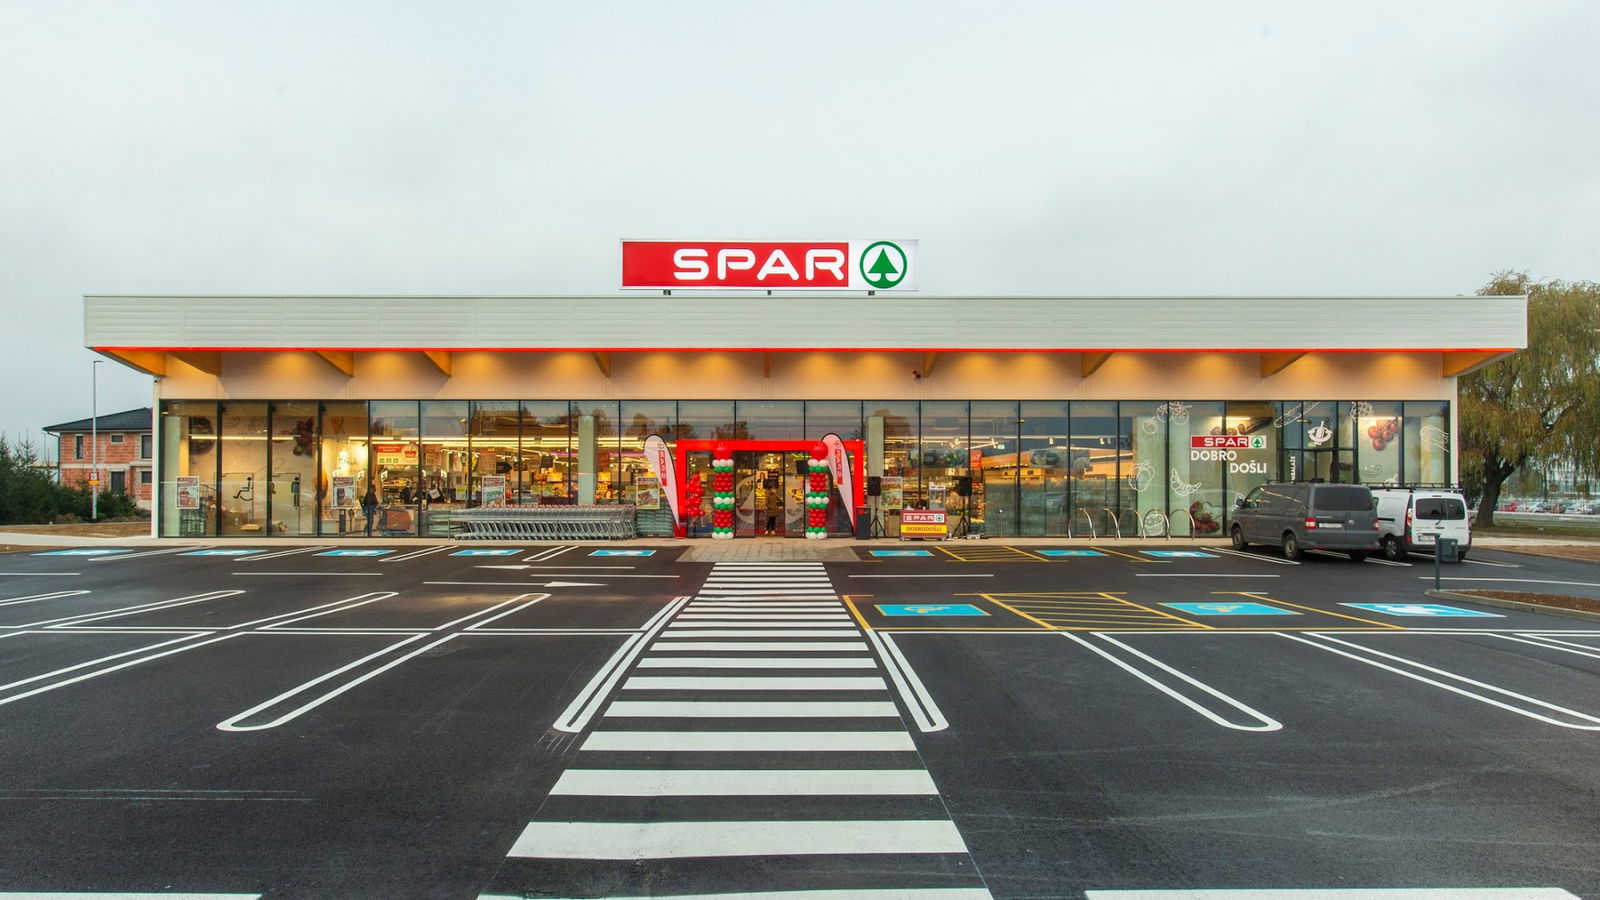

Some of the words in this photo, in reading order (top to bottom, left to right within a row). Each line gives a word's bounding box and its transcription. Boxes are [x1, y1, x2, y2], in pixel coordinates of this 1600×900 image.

[673, 248, 845, 281] SPAR
[1204, 437, 1248, 447] SPAR
[1190, 450, 1237, 461] DOBRO
[1230, 460, 1267, 473] DOŠLI
